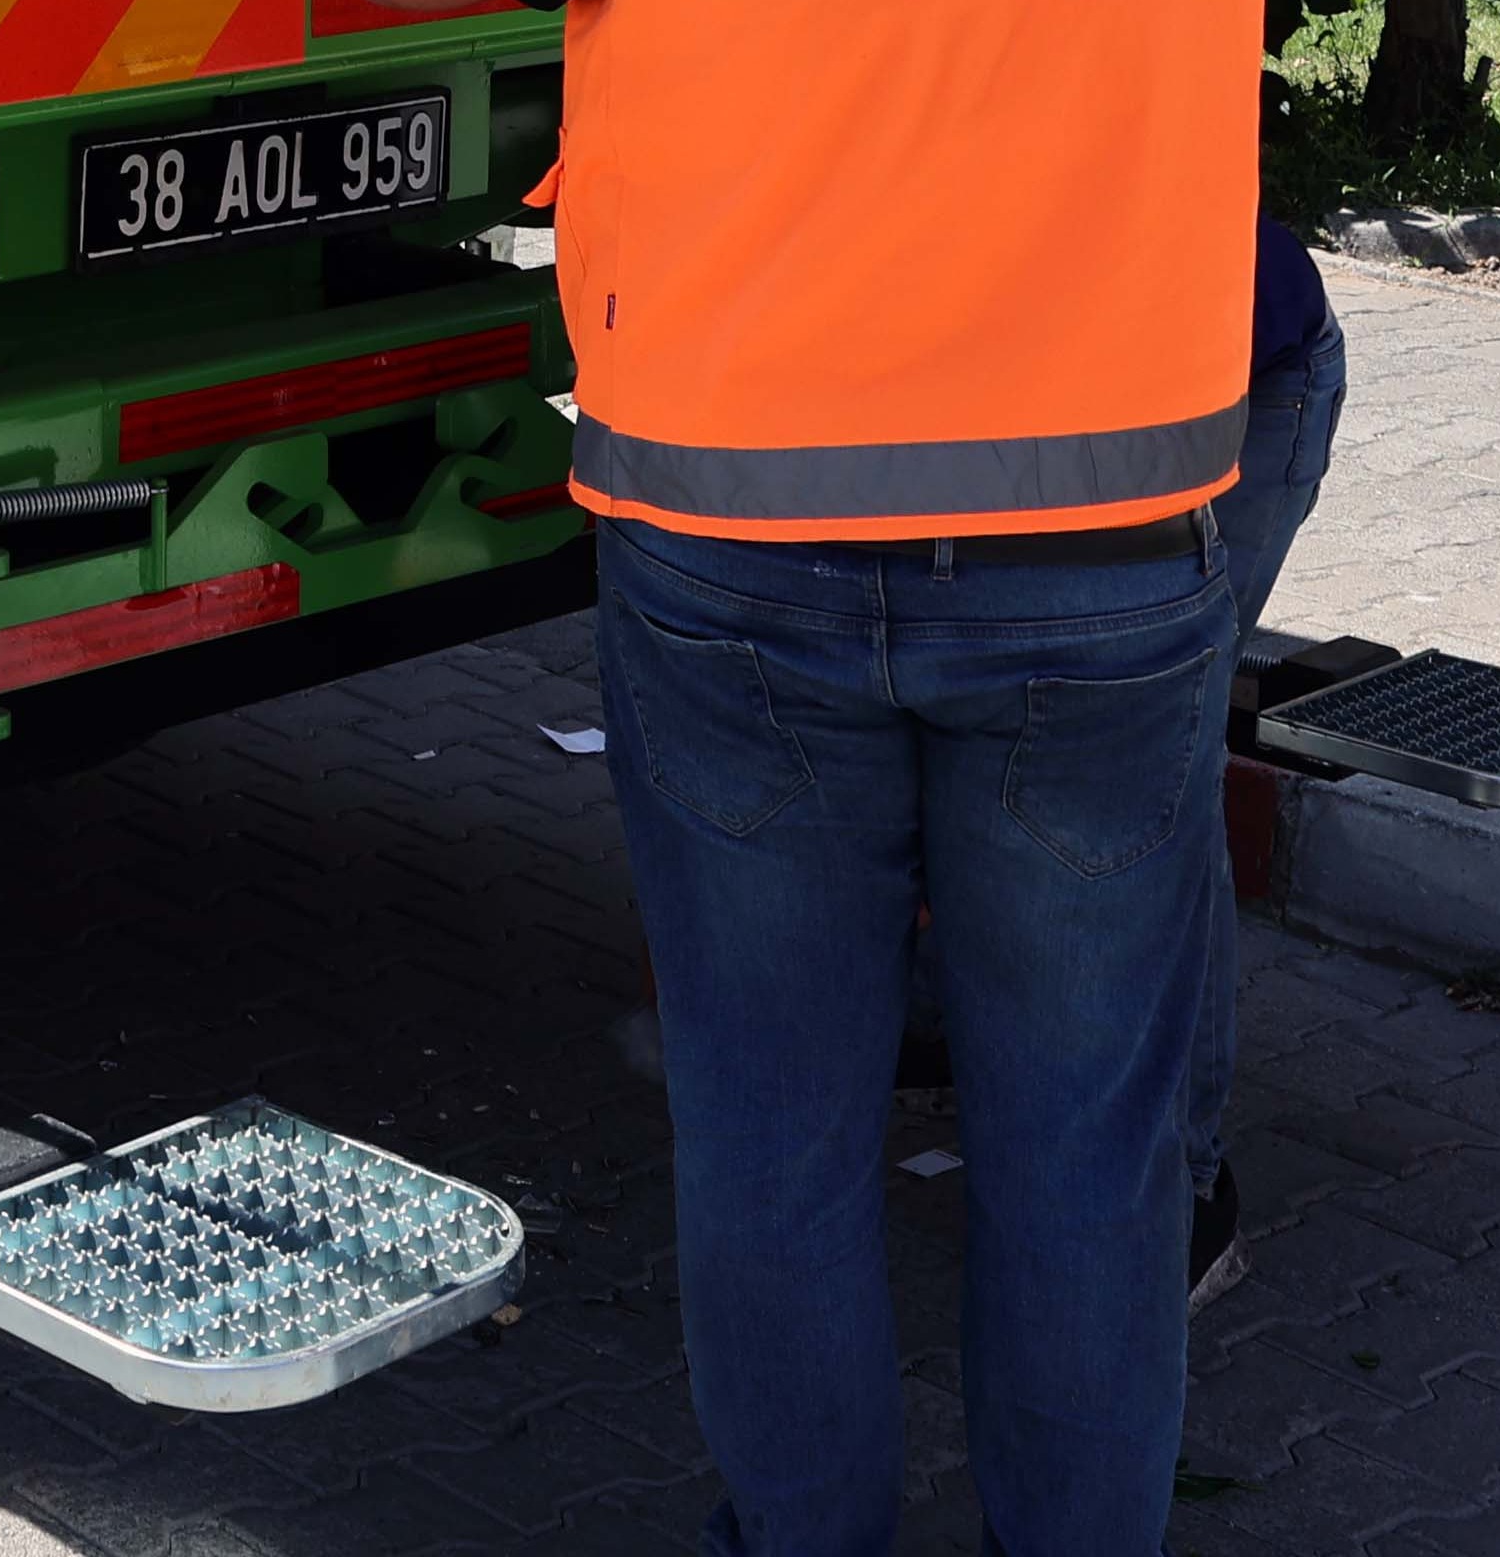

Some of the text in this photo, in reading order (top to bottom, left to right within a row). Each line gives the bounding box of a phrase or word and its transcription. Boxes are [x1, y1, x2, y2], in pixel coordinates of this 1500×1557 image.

[118, 112, 434, 237] 38 AOL 959
